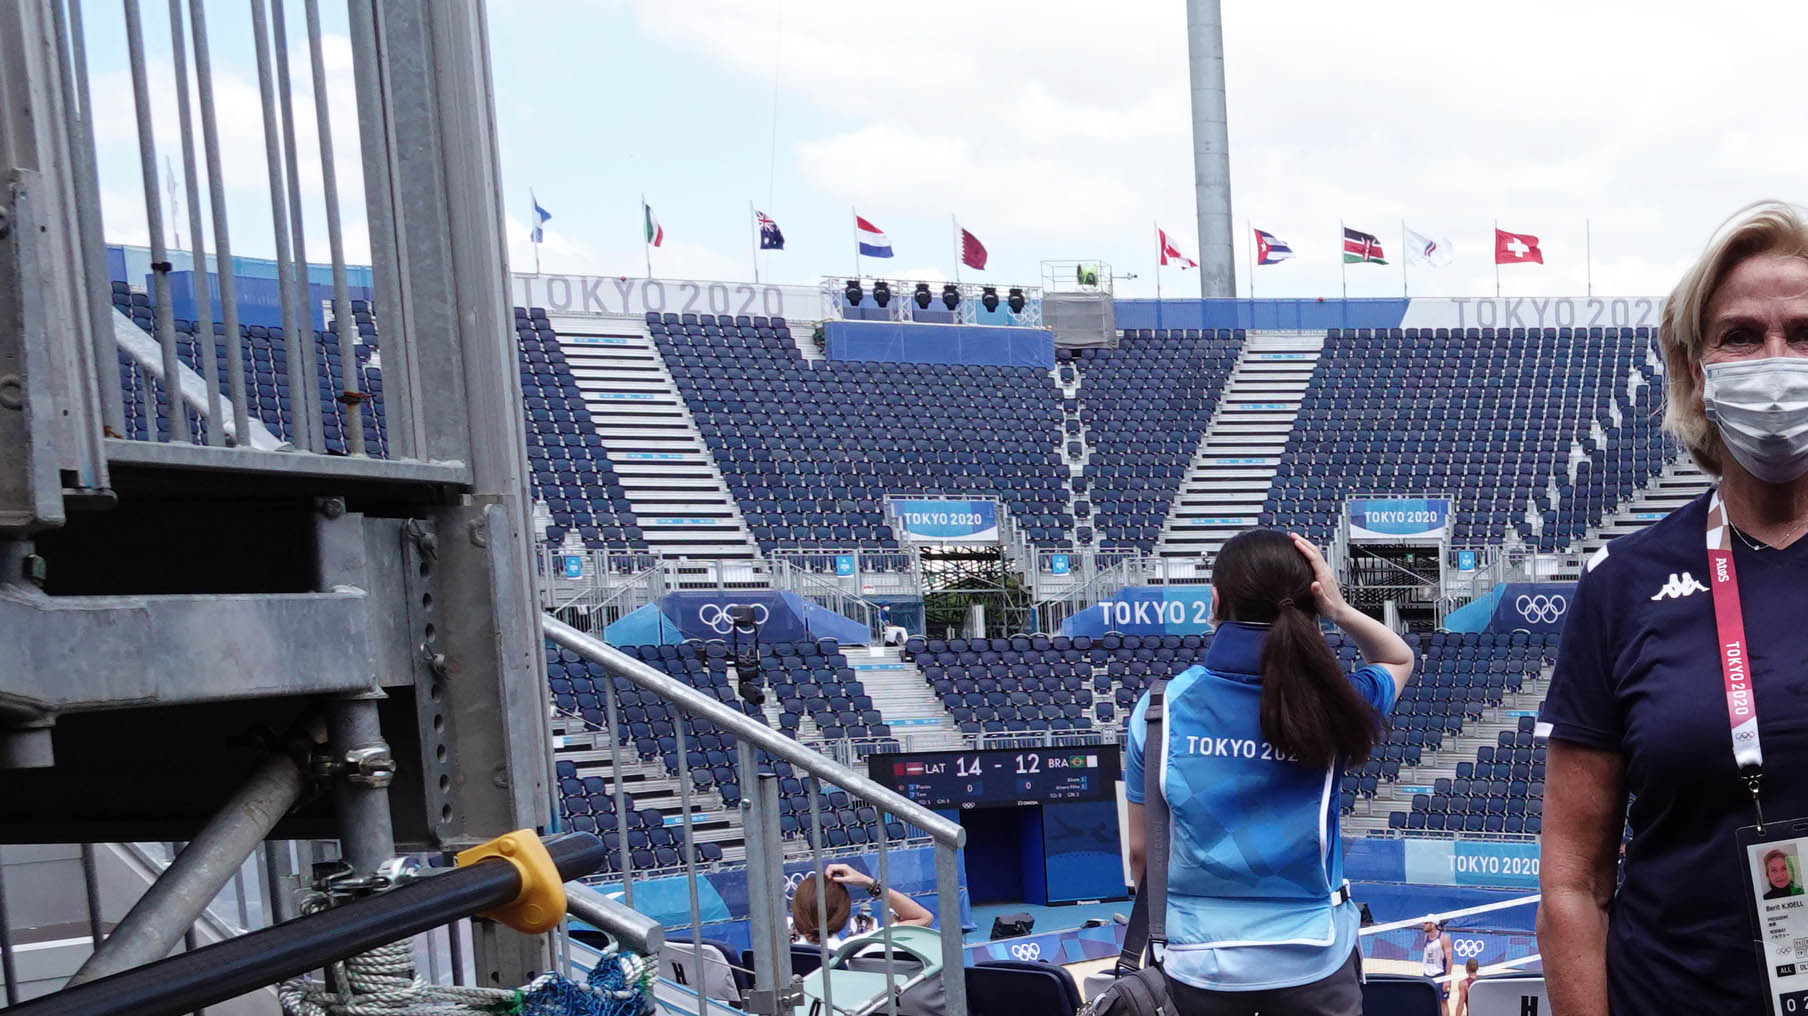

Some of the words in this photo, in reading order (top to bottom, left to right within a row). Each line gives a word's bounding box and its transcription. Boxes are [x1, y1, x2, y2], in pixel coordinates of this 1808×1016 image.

[514, 276, 667, 314] TOKYO
[679, 280, 784, 317] 2020
[1451, 297, 1575, 328] TOKYO
[1586, 297, 1664, 328] 202
[904, 512, 948, 525] TOKYO
[950, 513, 982, 525] 2020
[1364, 511, 1405, 523] TOKYO
[1407, 511, 1437, 523] 2020
[1098, 600, 1185, 625] TOKYO
[1725, 641, 1744, 681] TOKYO
[1731, 682, 1749, 715] 2020
[1186, 735, 1256, 758] TOKYO
[1261, 742, 1300, 762] 202
[925, 763, 947, 775] LAT
[956, 756, 983, 777] 14
[1015, 753, 1041, 774] 12
[1048, 758, 1069, 768] BRA
[967, 784, 973, 793] 0
[1025, 782, 1032, 790] 0
[1448, 855, 1499, 873] TOKYO
[1502, 857, 1540, 875] 2020
[672, 962, 688, 985] H
